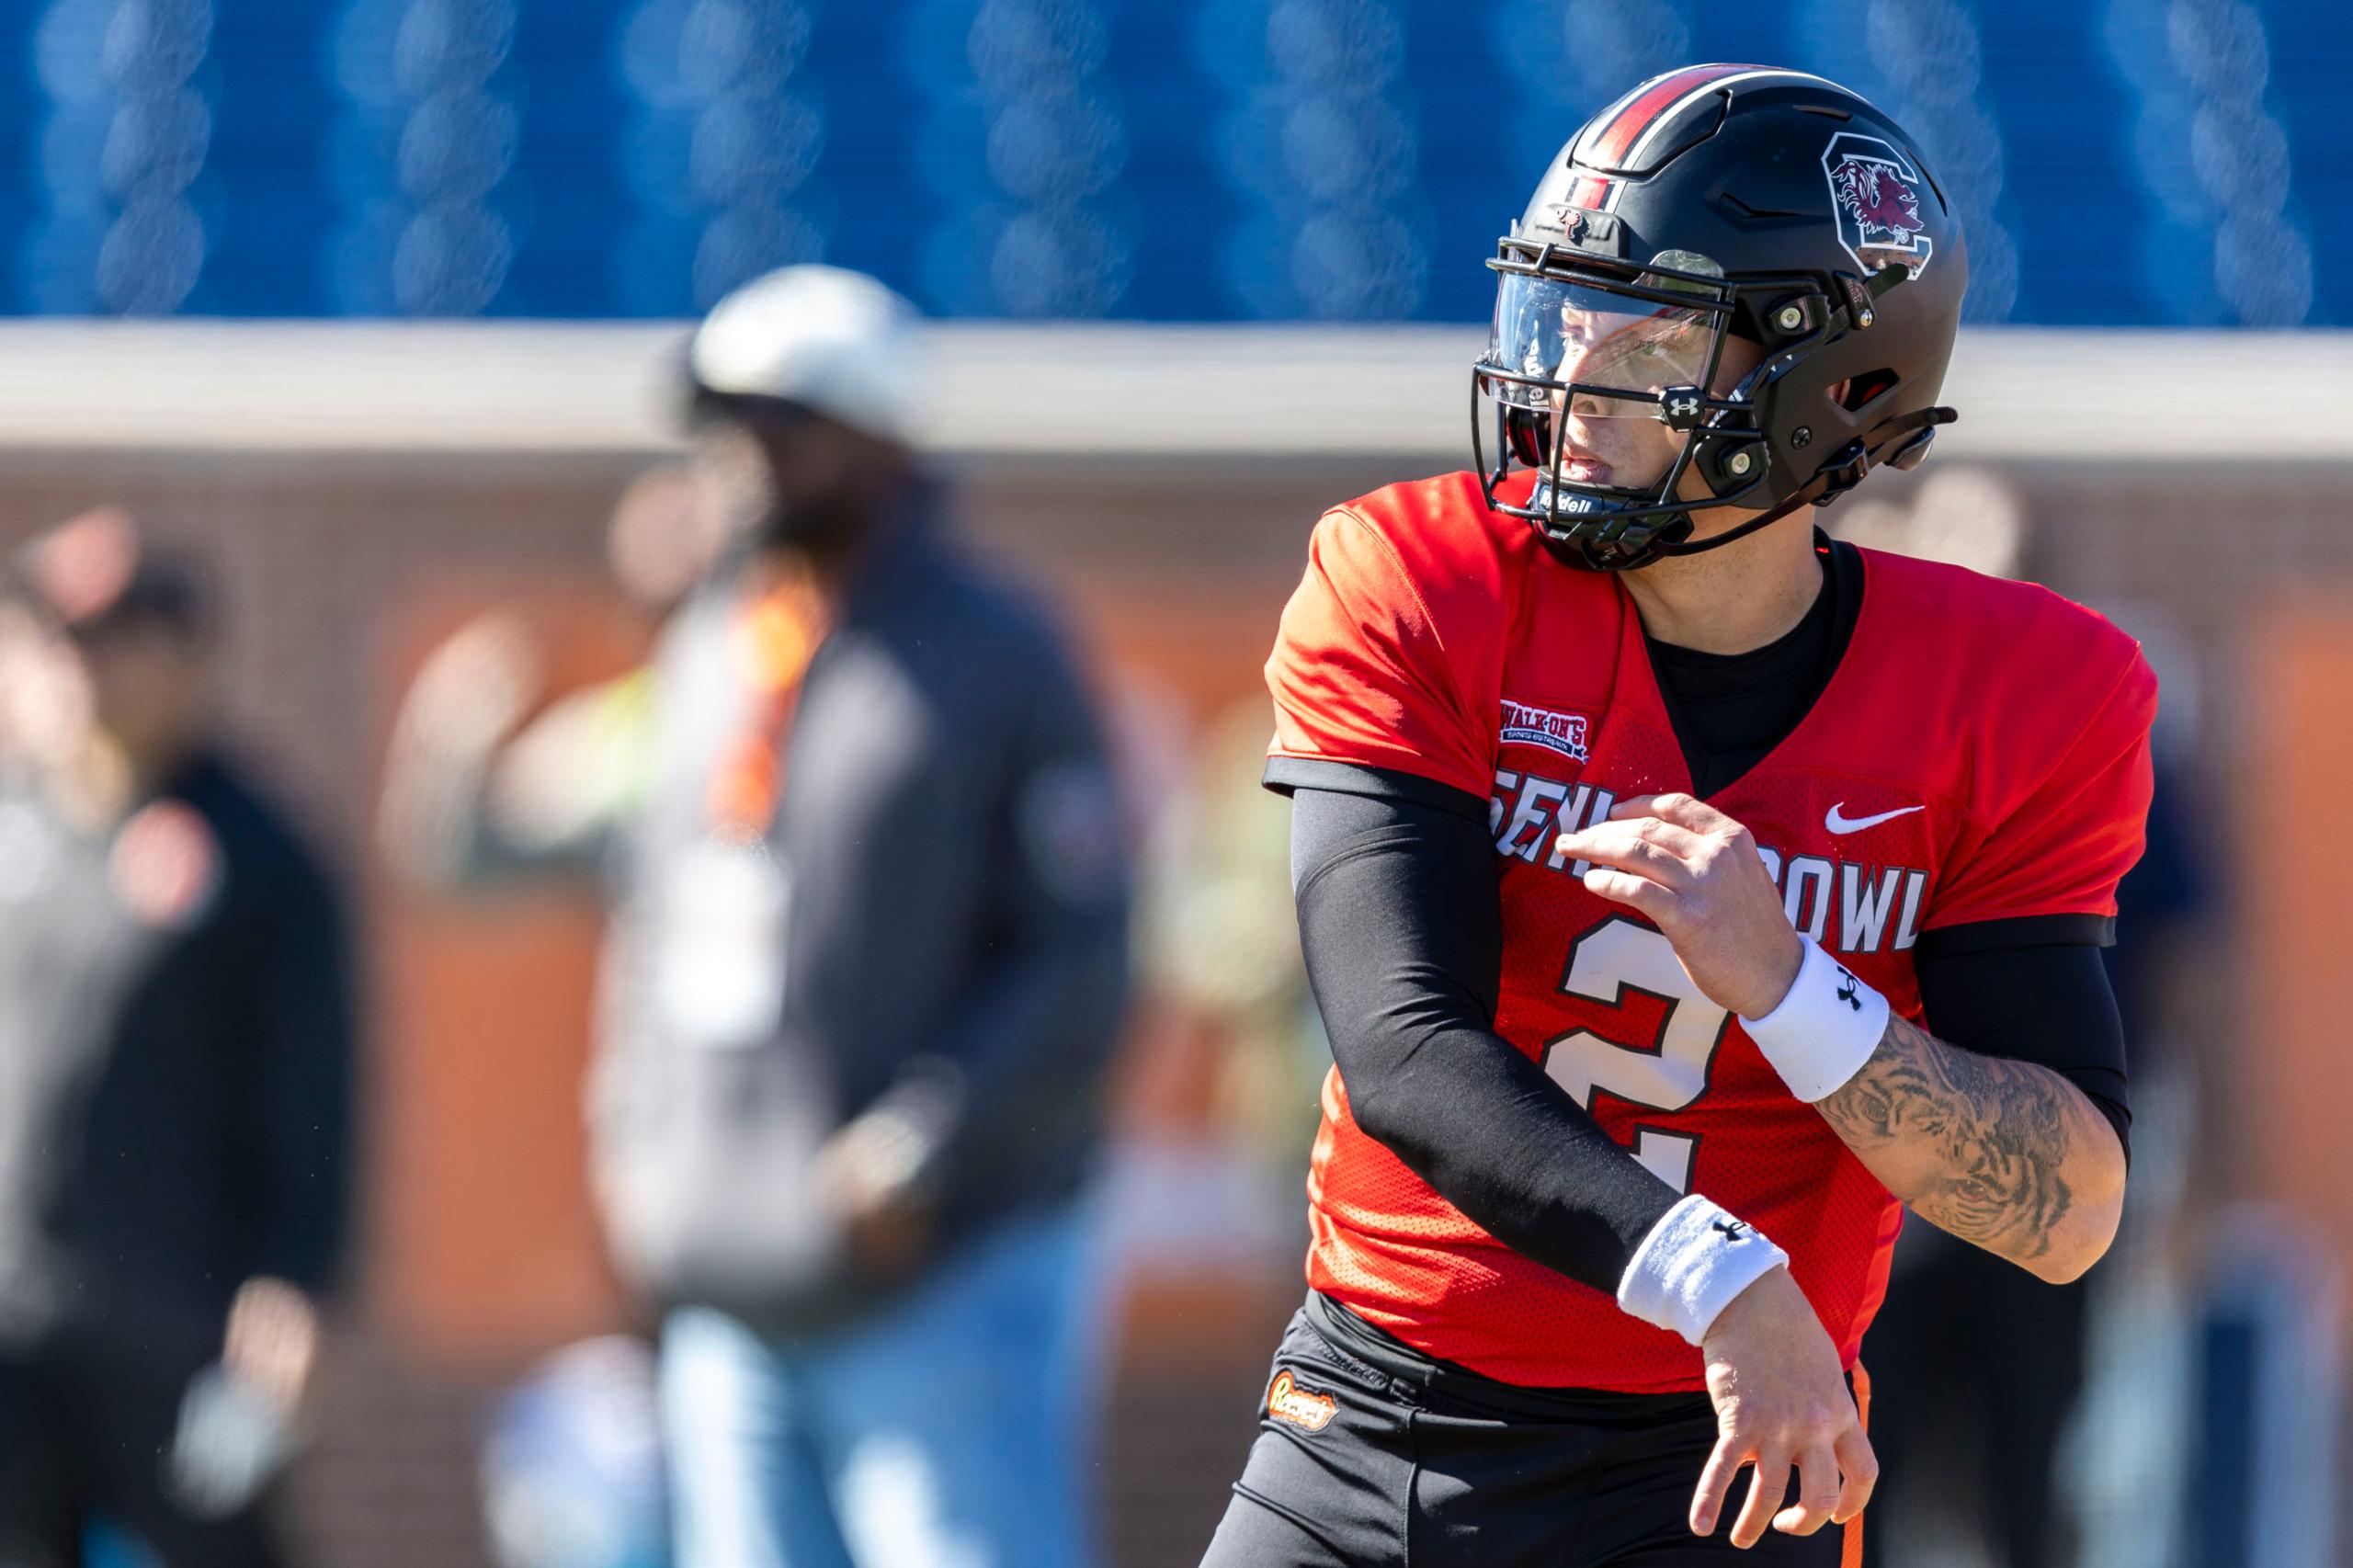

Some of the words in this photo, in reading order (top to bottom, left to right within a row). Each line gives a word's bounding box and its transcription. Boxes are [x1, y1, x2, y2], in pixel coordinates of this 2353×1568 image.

[1540, 489, 1592, 513] Rdell
[1490, 767, 1620, 881] SENI
[1538, 911, 1732, 1196] 2
